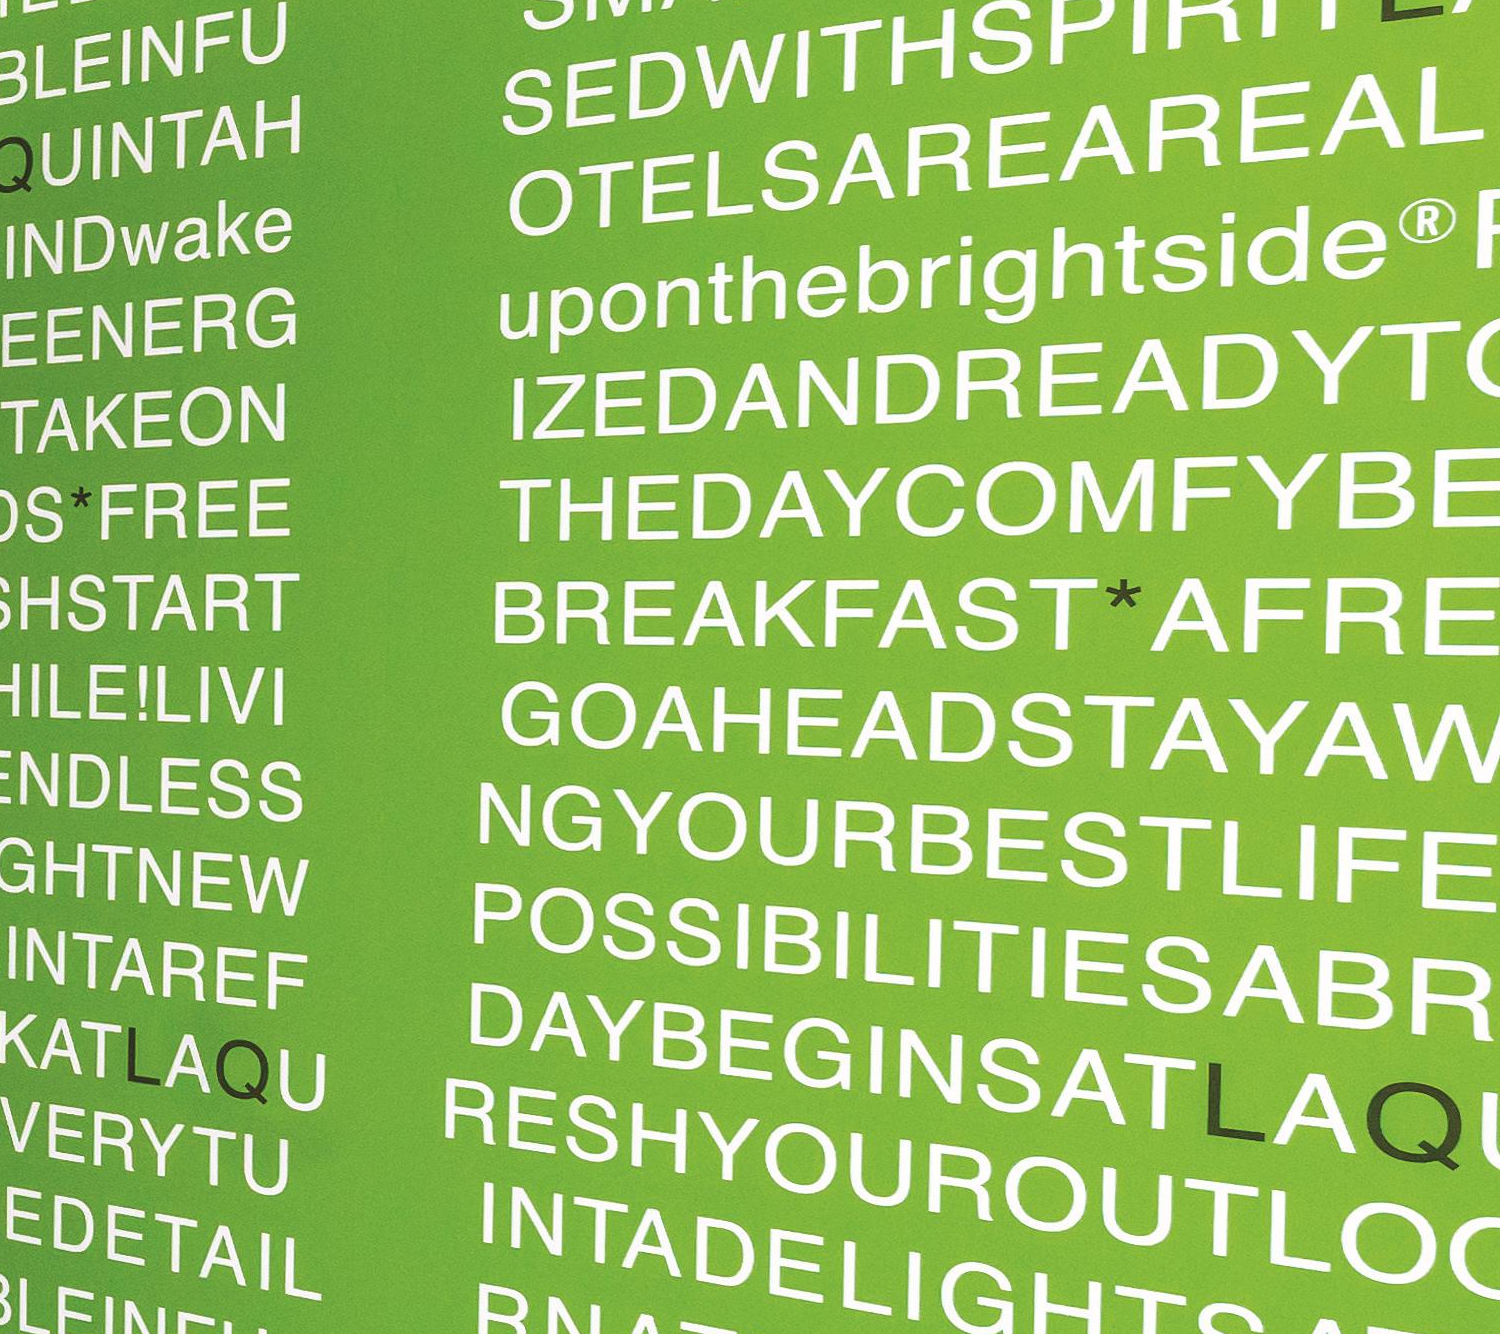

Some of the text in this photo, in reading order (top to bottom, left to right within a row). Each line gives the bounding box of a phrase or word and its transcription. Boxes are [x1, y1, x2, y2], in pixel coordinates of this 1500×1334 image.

[510, 67, 1484, 236] OTELSAREAREAL
[499, 448, 1500, 542] THEDAYCOMFYBE
[502, 681, 1498, 784] GOAHEADSTAYAW
[480, 782, 1498, 913] NGYOURBESTLIFE
[474, 883, 1494, 1041] POSSIBILITIESABR
[470, 983, 1500, 1170] DAYBEGINSATLAQ
